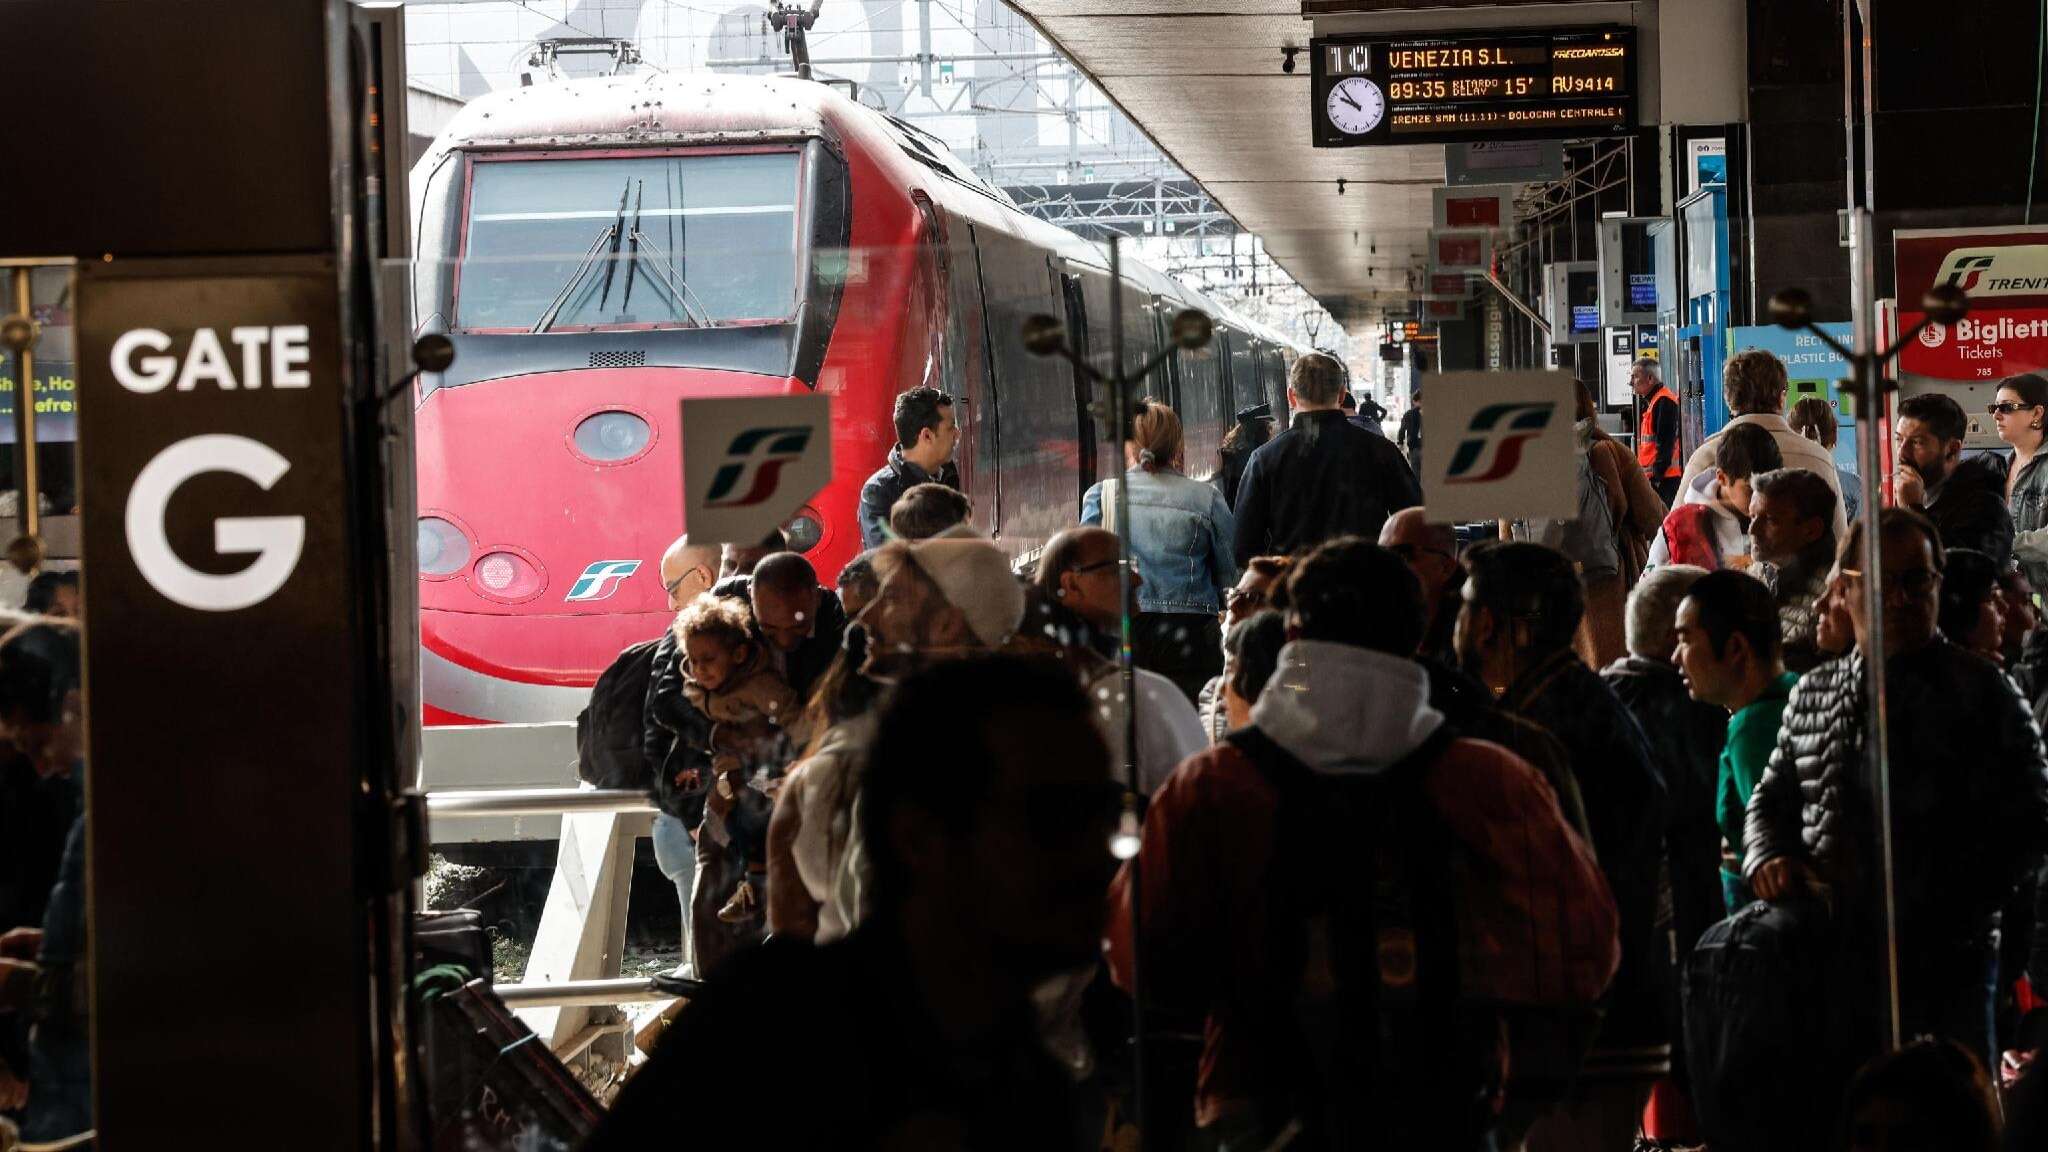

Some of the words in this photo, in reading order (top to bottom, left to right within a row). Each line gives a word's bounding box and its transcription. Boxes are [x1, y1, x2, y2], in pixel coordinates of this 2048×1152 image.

[1331, 46, 1369, 72] 10
[1389, 49, 1473, 69] VENEZIA
[1479, 47, 1515, 66] S.L.
[1390, 81, 1446, 99] 09:35
[1452, 79, 1498, 89] RITARDO
[1505, 77, 1534, 95] 15'
[1453, 87, 1487, 97] DELAY
[1508, 110, 1556, 120] BOLOGNA
[1560, 107, 1614, 118] CENTRALE
[110, 325, 311, 394] GATE
[1957, 345, 2004, 360] Tickets
[1977, 367, 1993, 377] 785
[125, 433, 306, 613] G
